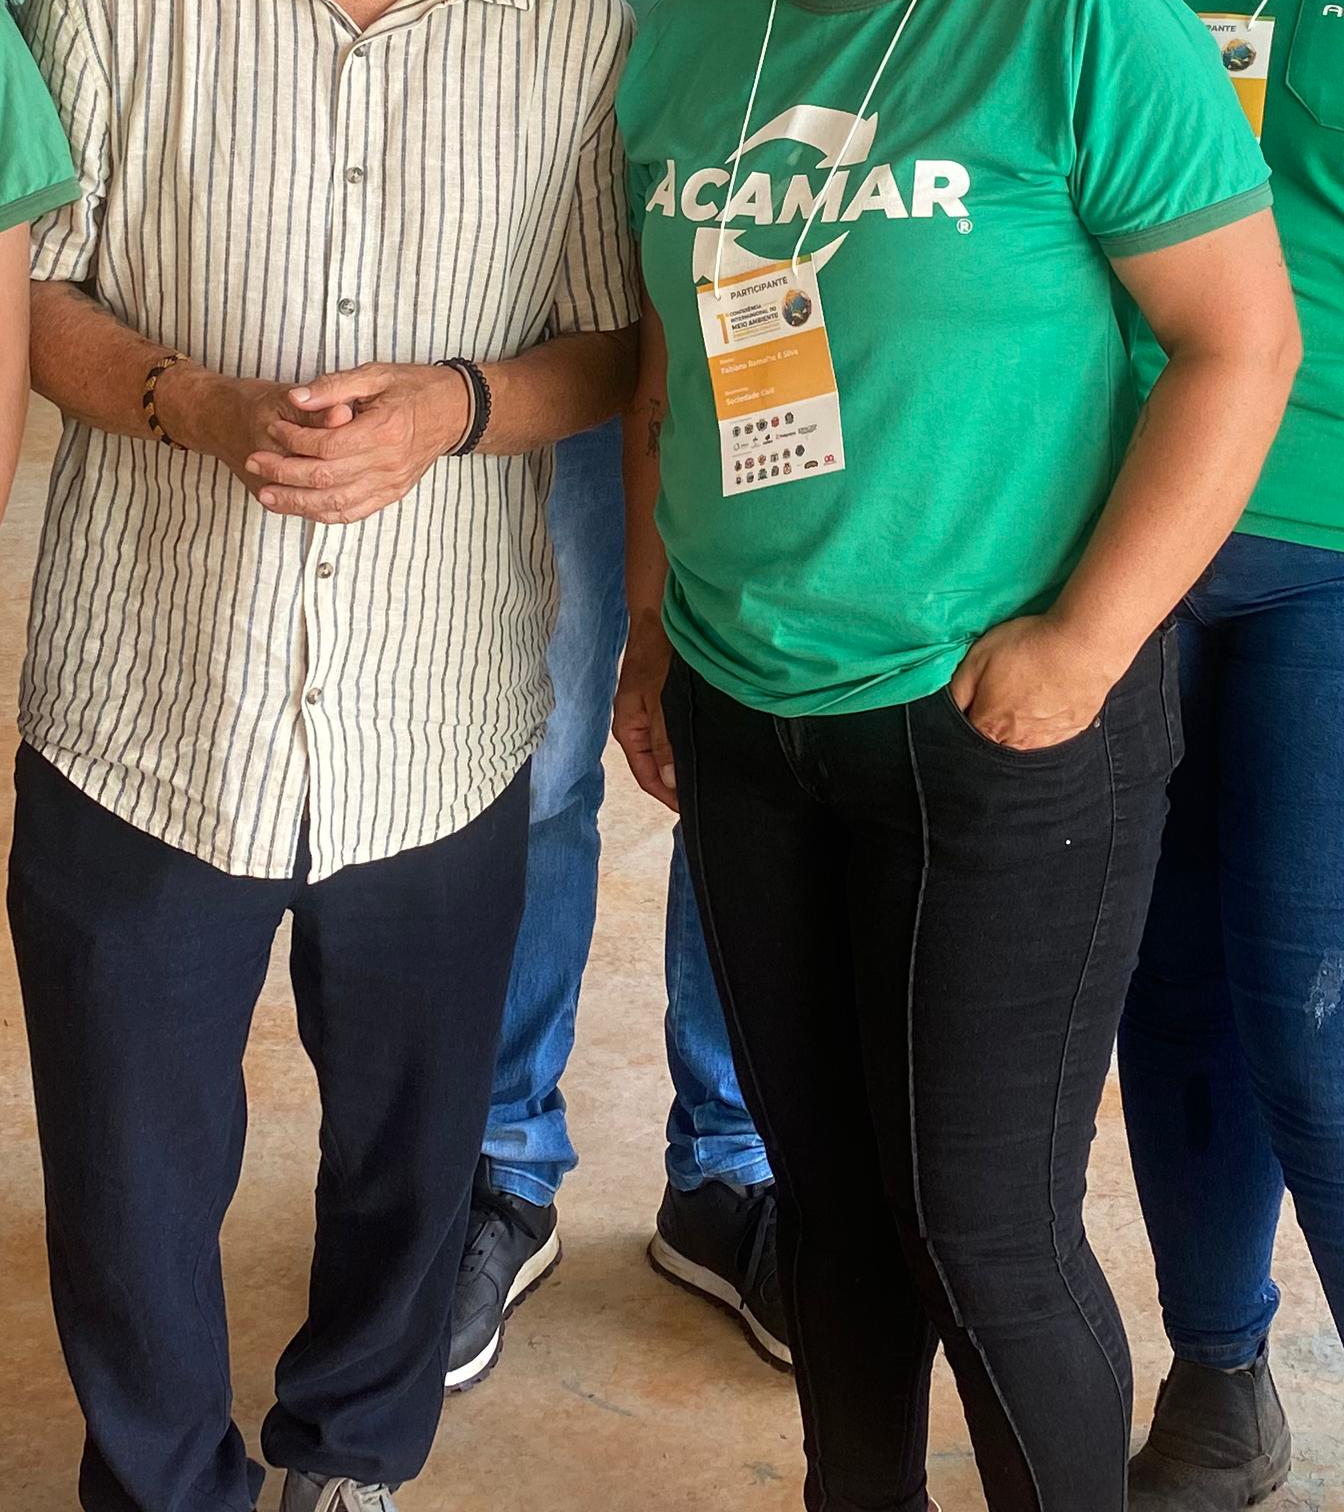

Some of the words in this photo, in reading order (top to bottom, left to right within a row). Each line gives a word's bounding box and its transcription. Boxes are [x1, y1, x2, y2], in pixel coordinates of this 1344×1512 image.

[645, 159, 971, 225] ACAMAR
[730, 276, 788, 300] PARTICIPANTE
[731, 322, 748, 330] MEIO
[748, 312, 779, 326] AMBIENTE
